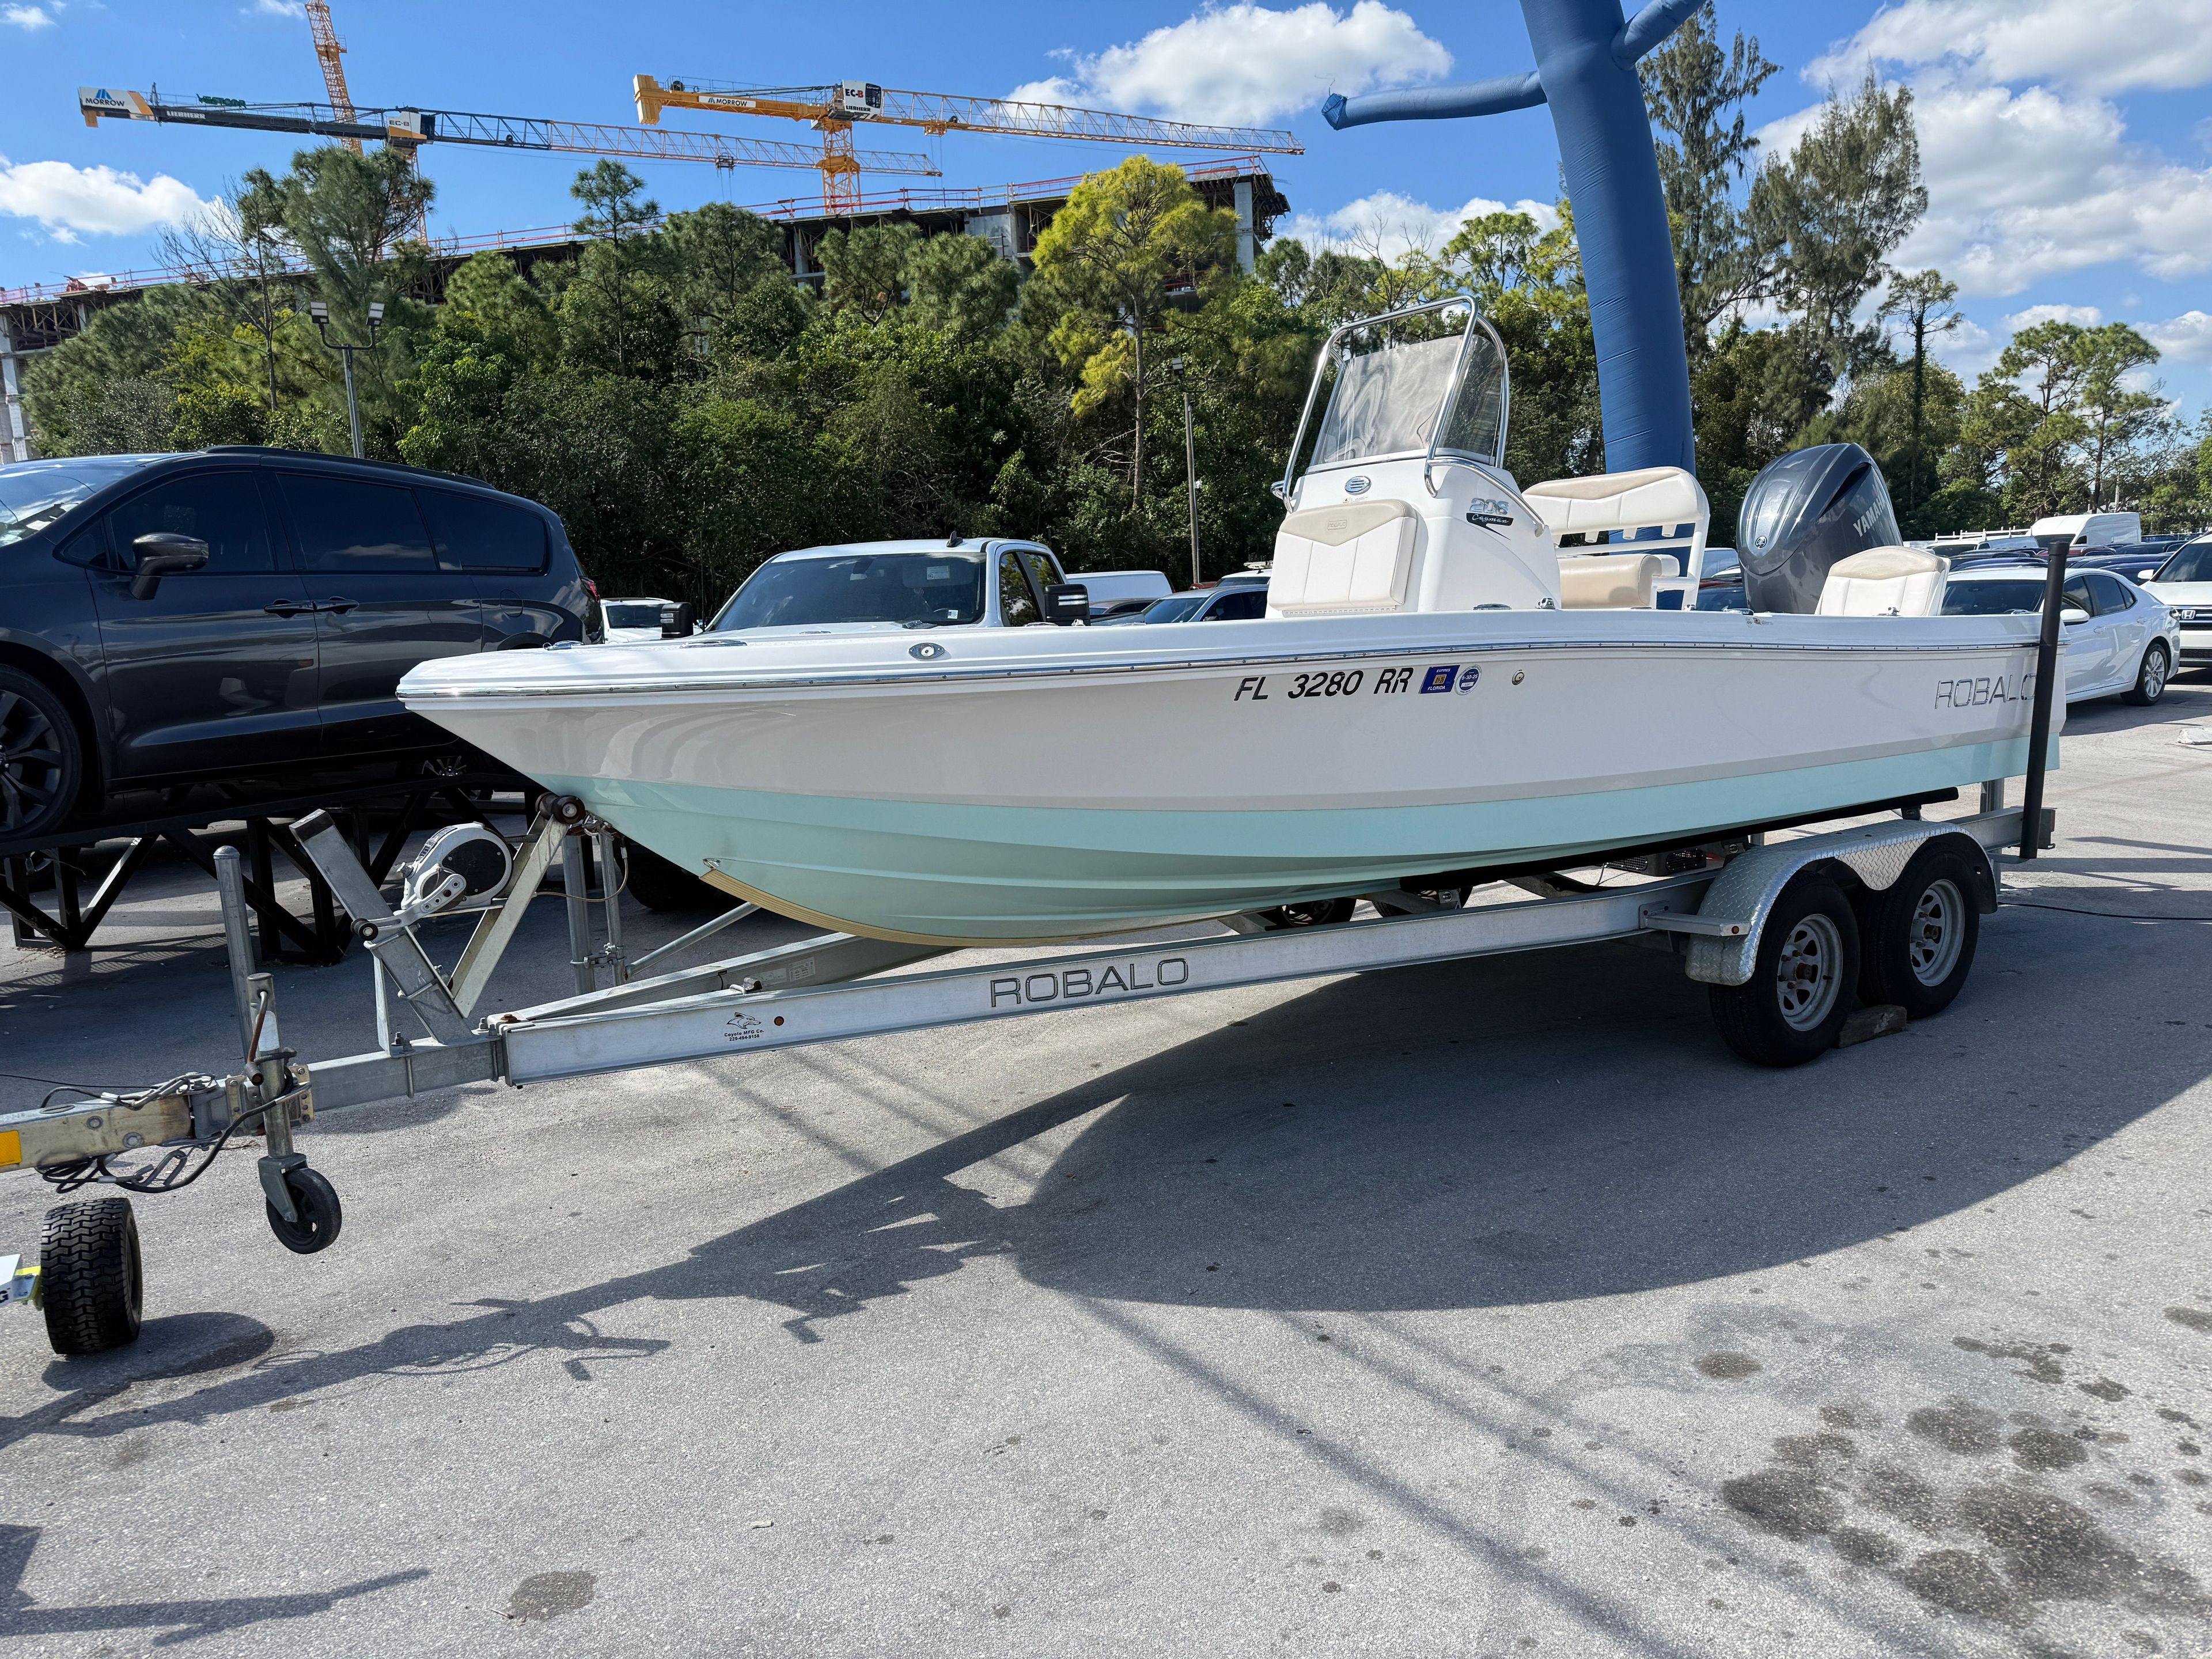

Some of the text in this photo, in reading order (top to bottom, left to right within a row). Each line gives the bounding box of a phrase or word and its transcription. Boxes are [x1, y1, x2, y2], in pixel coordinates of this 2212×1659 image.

[845, 89, 864, 98] EC-B
[86, 97, 125, 107] MORROW
[716, 98, 748, 107] MORROW
[166, 110, 206, 120] LIEBHERR
[1469, 498, 1509, 515] 206
[1472, 514, 1509, 523] Cayman
[1234, 667, 1414, 701] FL 3280 RR
[1934, 673, 2037, 709] ROBALO
[990, 957, 1189, 1008] ROBALO
